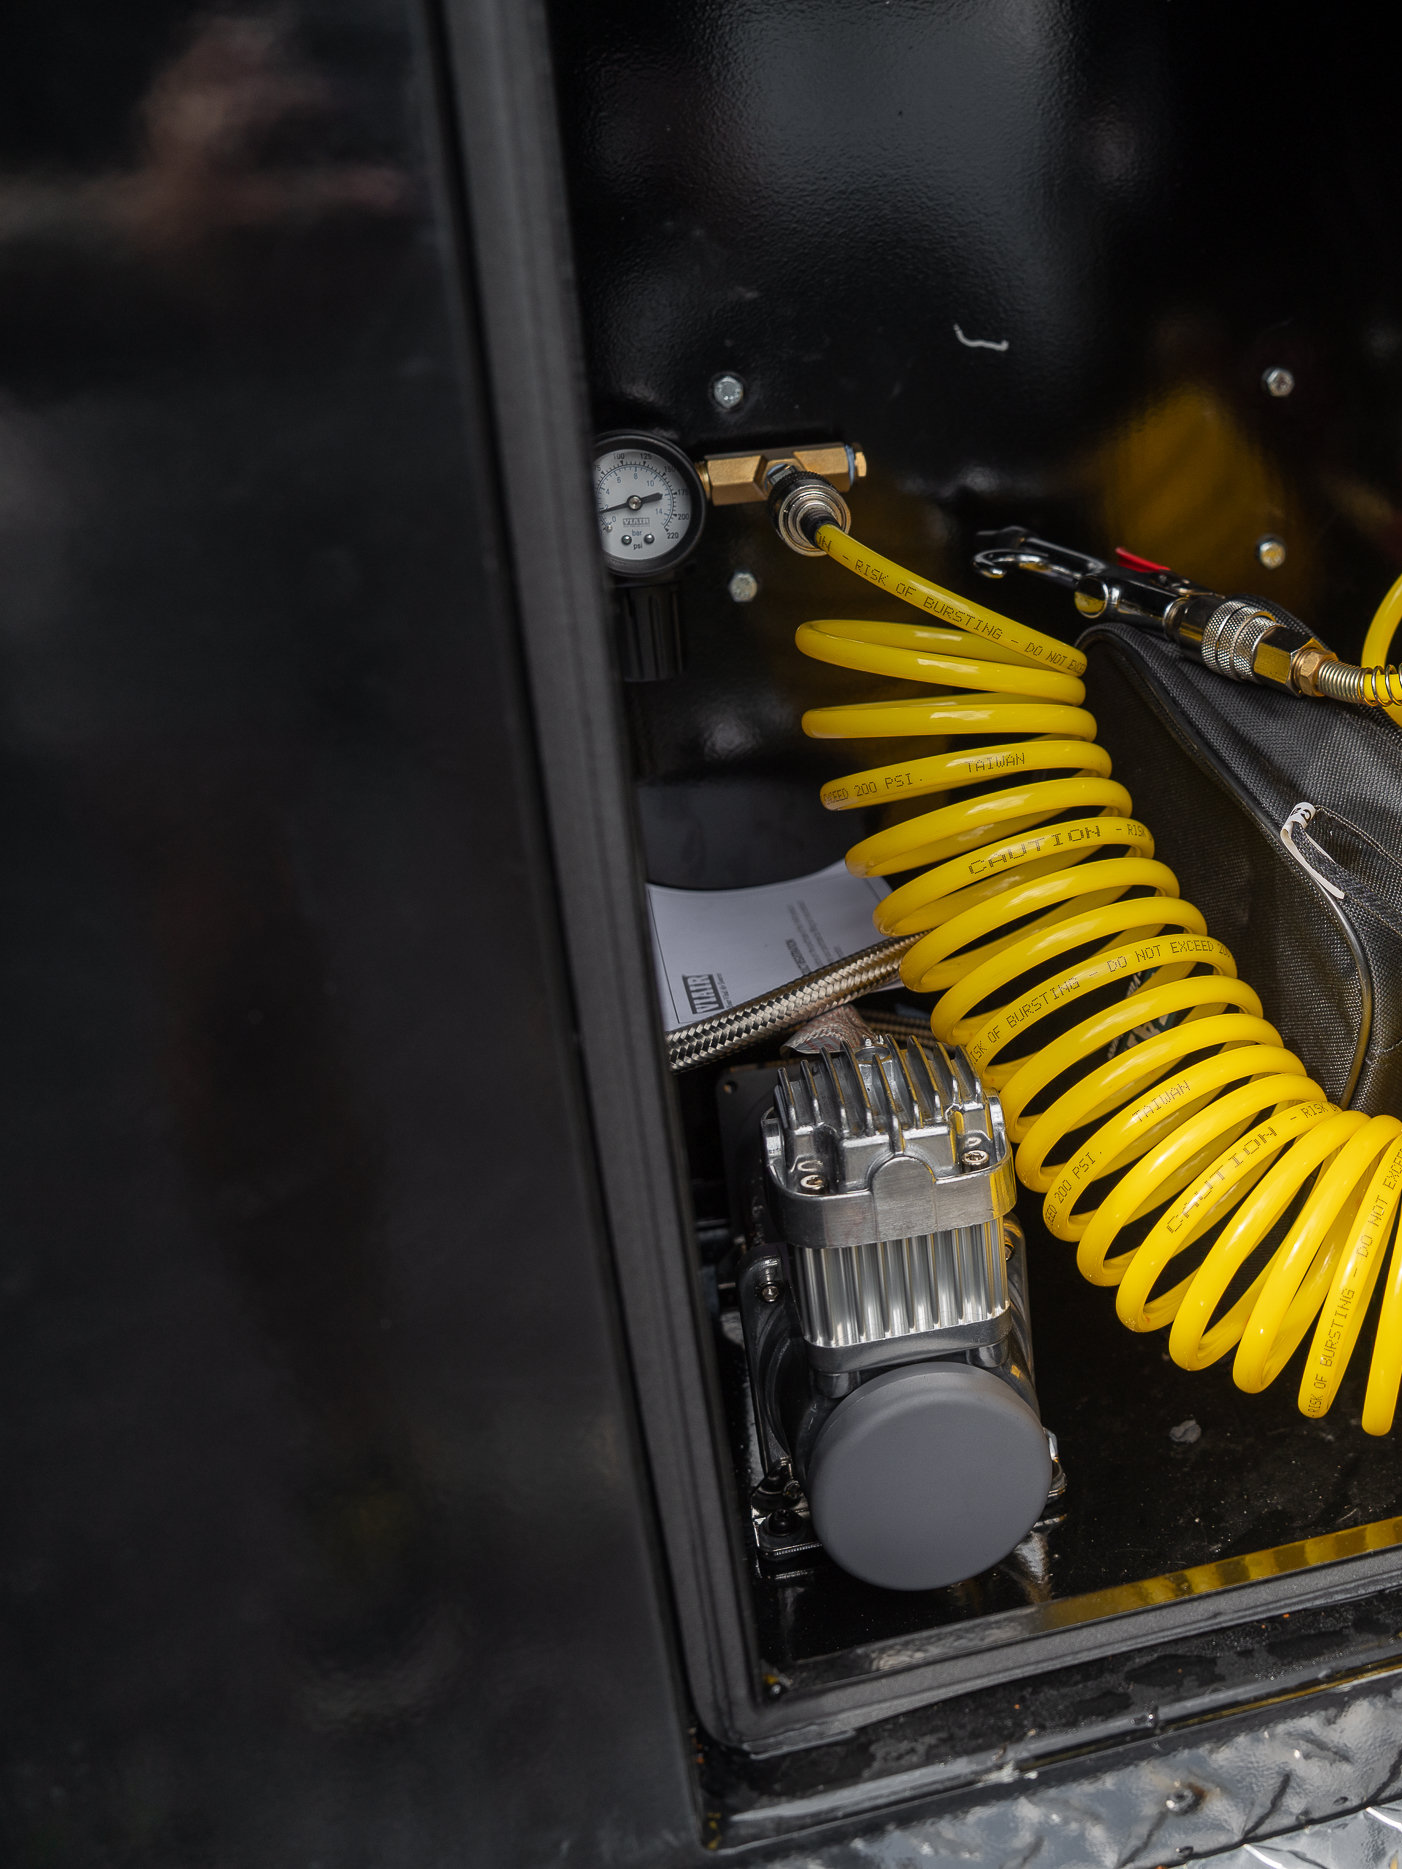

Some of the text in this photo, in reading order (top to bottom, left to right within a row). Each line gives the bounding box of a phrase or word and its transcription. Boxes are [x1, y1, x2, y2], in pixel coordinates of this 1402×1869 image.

[677, 513, 690, 521] 200
[633, 542, 643, 550] psi
[855, 560, 889, 586] RISK
[895, 582, 917, 597] OF
[923, 596, 1003, 641] BURSTING
[1024, 642, 1043, 657] DO
[1047, 650, 1068, 666] NOT
[965, 752, 1025, 773] TAIWAN
[853, 781, 877, 797] 200
[885, 772, 922, 789] PSI.
[968, 825, 1101, 875] CAUTION
[685, 974, 721, 1014] VIAIR
[970, 1040, 988, 1065] ISK
[987, 1025, 1001, 1043] OF
[1005, 976, 1080, 1029] BURSTING
[1106, 955, 1128, 973] DO
[1135, 944, 1161, 963] NOT
[1170, 939, 1214, 954] EXCEED
[1132, 1079, 1191, 1122] TAIWAN
[1054, 1179, 1072, 1204] 200
[1071, 1151, 1102, 1180] PSI.
[1166, 1126, 1278, 1234] CAUTION
[1301, 1102, 1328, 1118] RISK
[1367, 1195, 1388, 1227] NOT
[1356, 1234, 1373, 1258] DO
[1320, 1288, 1355, 1368] BURSTING
[1313, 1373, 1328, 1390] OF
